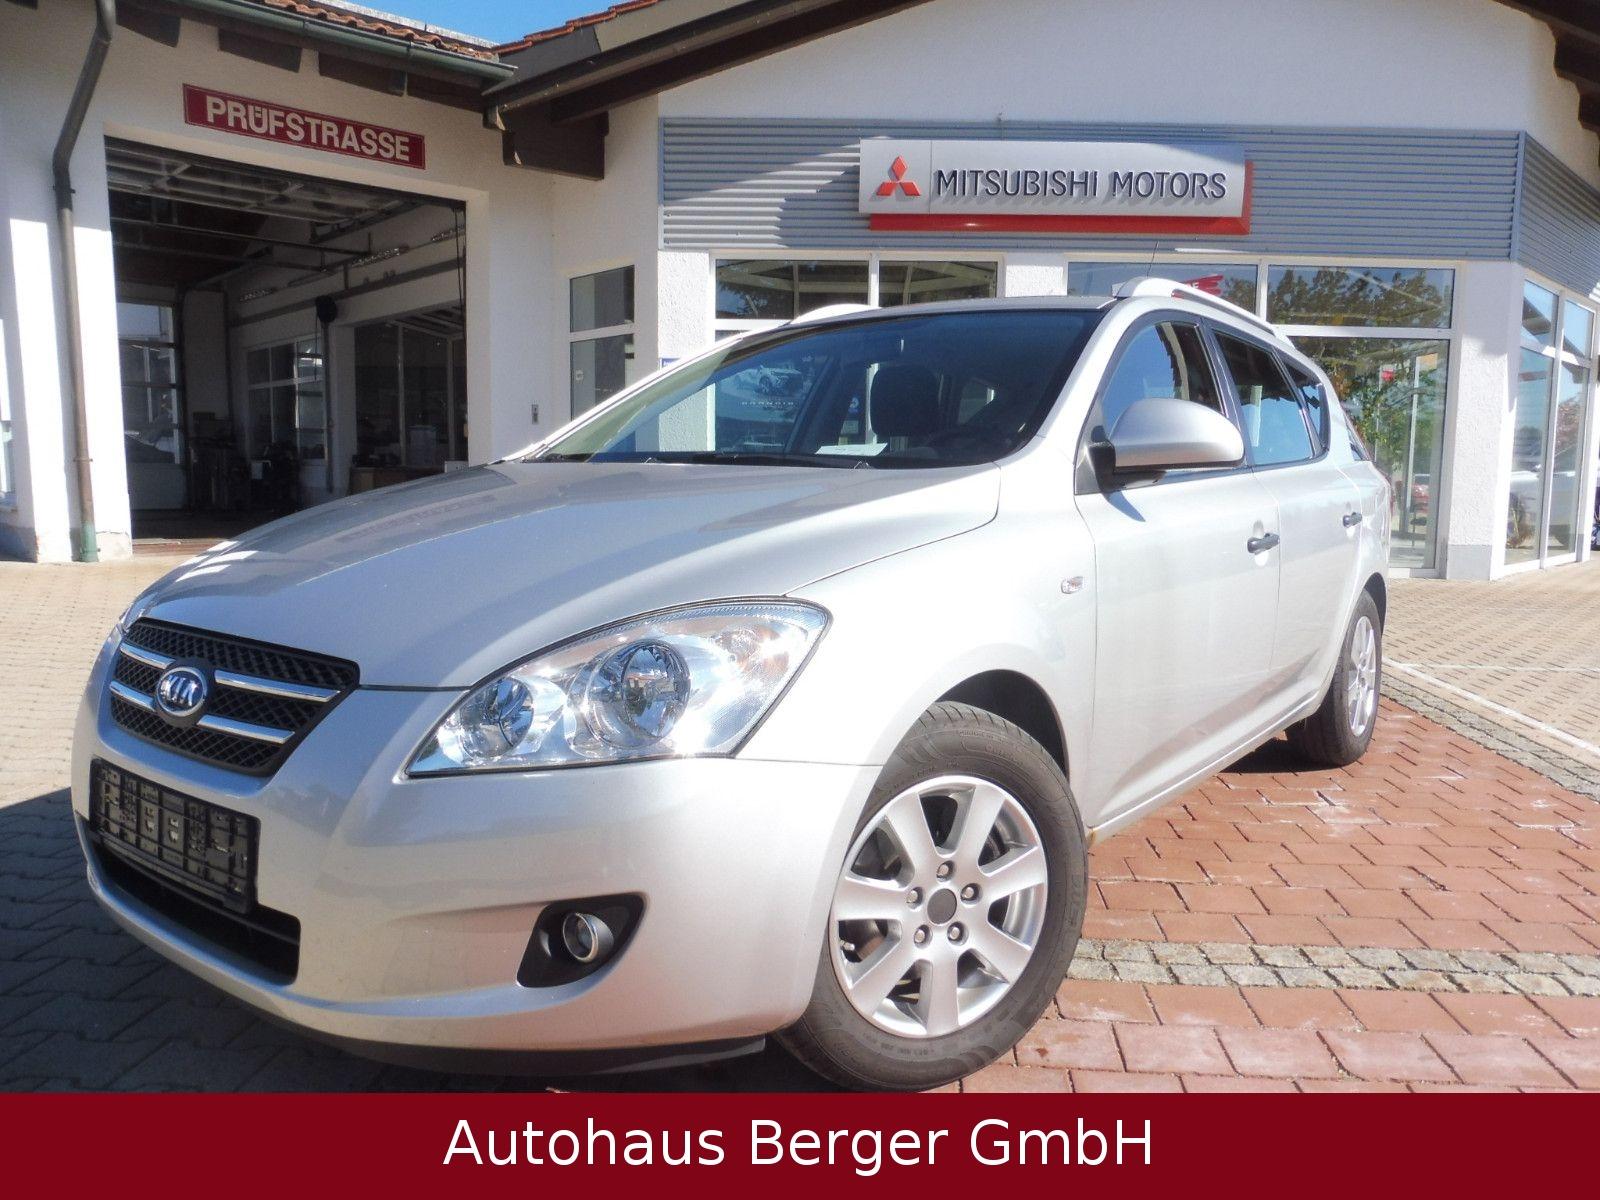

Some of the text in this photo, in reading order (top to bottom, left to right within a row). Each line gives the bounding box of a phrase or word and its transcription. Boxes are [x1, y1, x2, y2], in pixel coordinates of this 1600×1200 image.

[206, 95, 410, 162] PRÜFSTRASSE
[936, 169, 1226, 199] MITSUBISHI MOTORS
